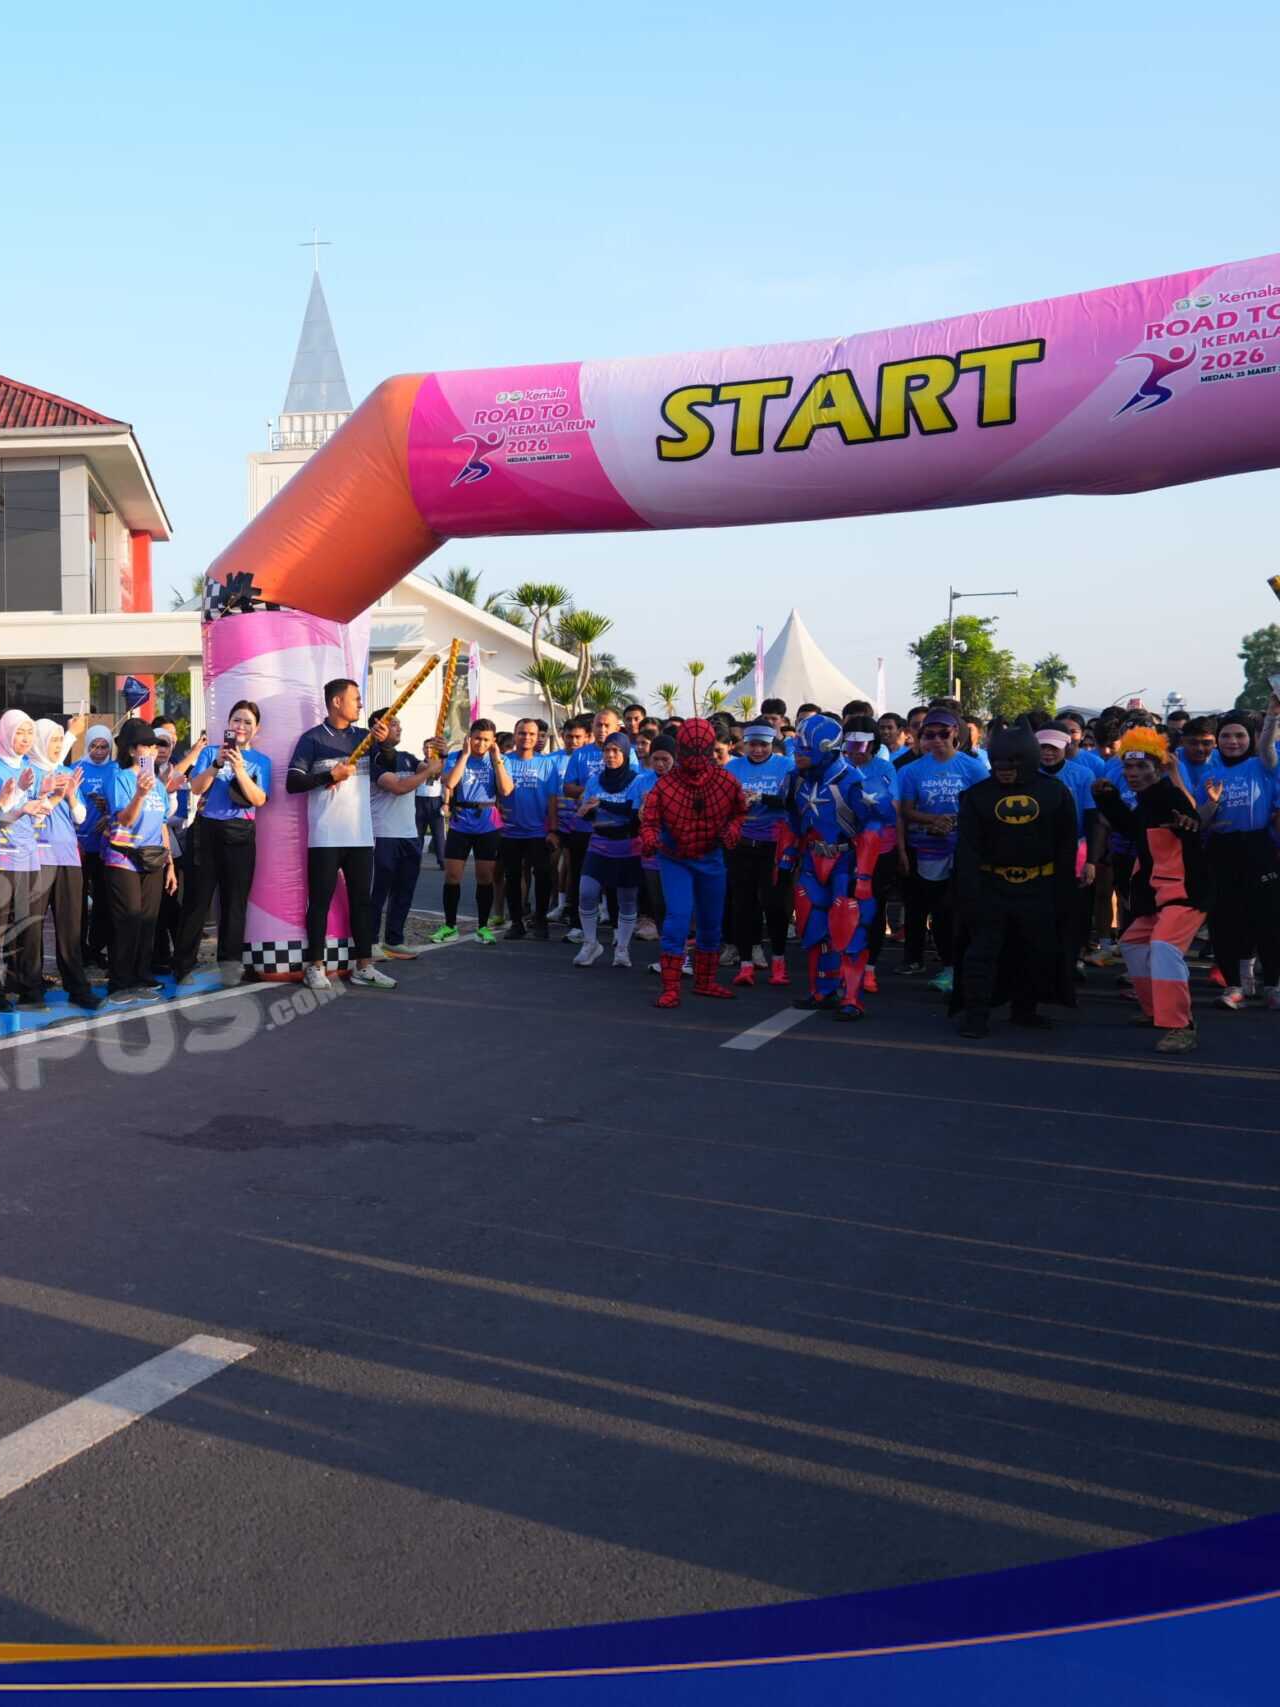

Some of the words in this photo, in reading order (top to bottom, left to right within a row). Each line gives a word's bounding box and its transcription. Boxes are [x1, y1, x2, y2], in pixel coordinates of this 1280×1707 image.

[1219, 284, 1280, 303] Kemala
[1146, 311, 1238, 340] ROAD
[1201, 348, 1264, 371] 2026
[1247, 366, 1276, 377] MARET
[525, 387, 566, 401] Kemala
[656, 338, 1046, 462] START
[474, 407, 534, 425] ROAD
[541, 404, 569, 419] TO
[508, 421, 567, 436] KEMALA
[568, 418, 596, 431] RUN
[508, 439, 548, 454] 2026
